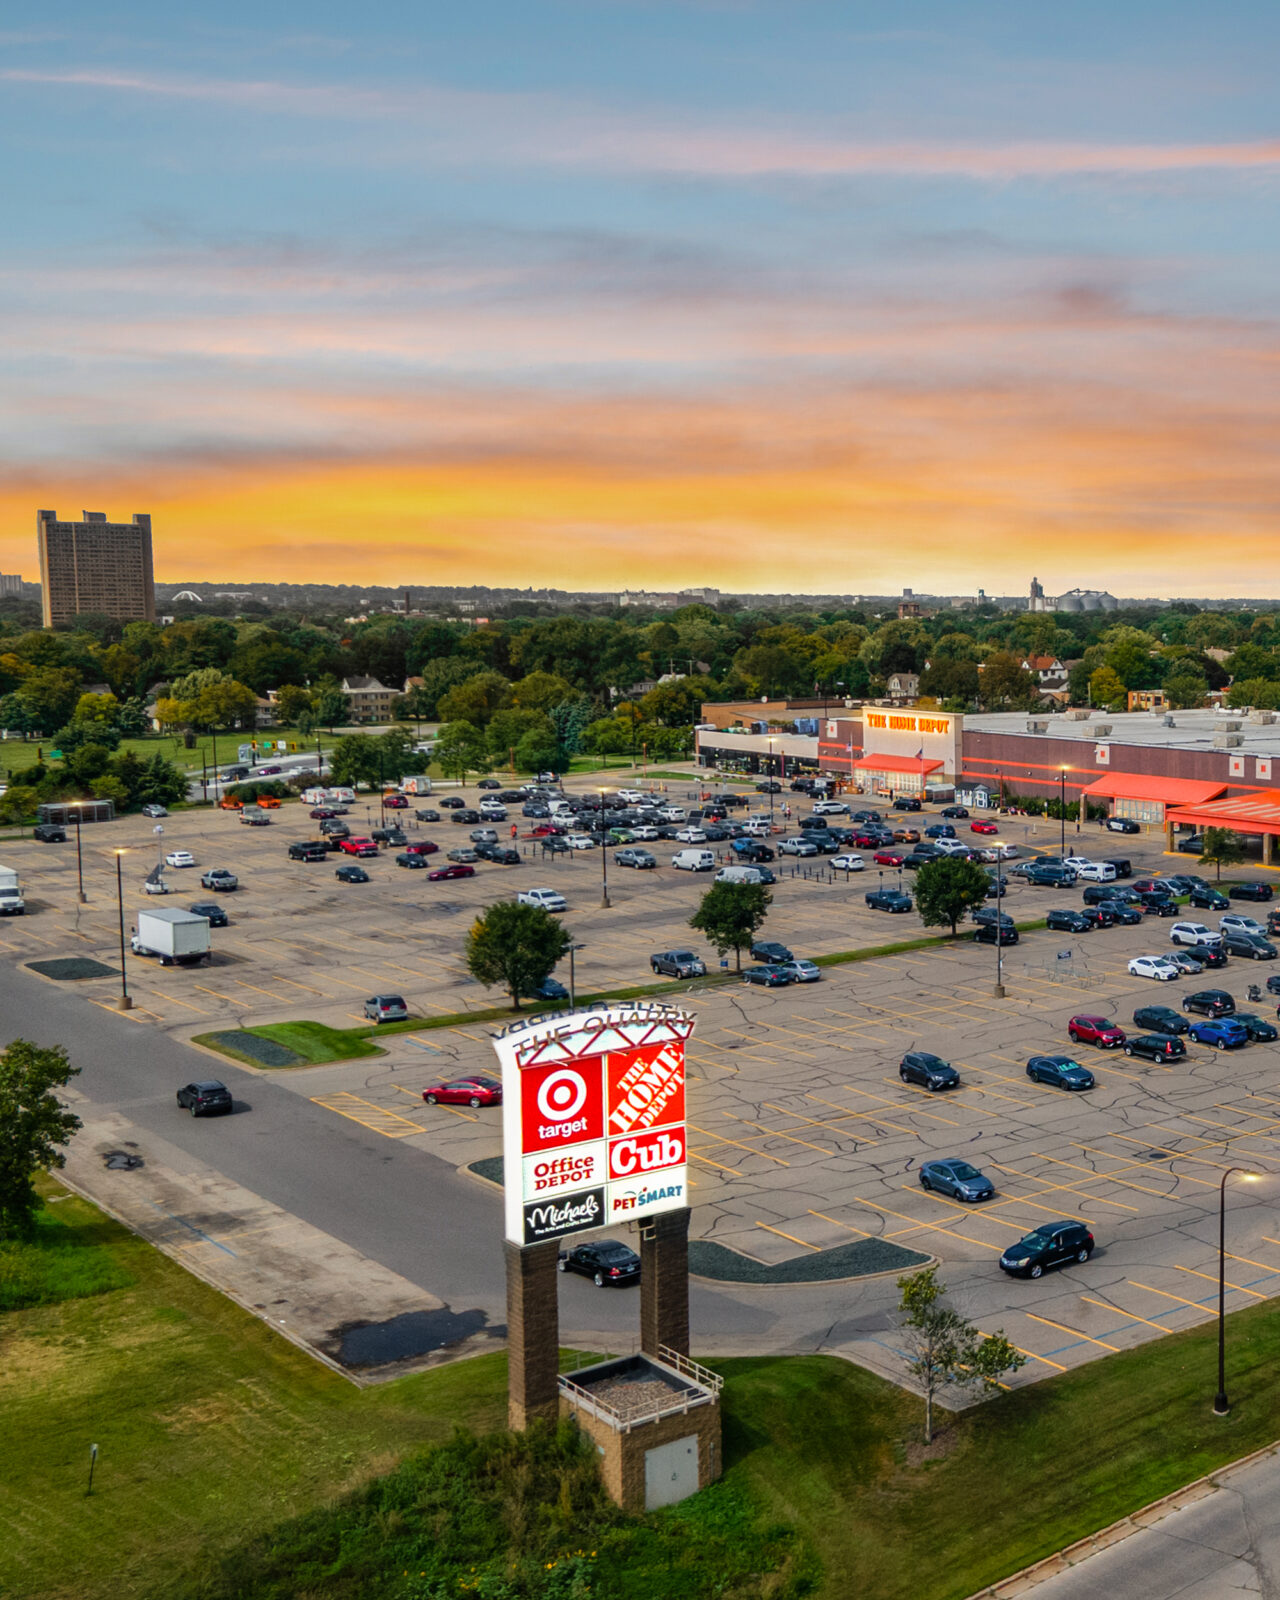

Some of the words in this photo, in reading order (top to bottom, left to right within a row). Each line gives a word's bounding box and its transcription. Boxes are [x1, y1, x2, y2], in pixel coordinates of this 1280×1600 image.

[867, 713, 886, 728] THE
[918, 718, 949, 734] DEPOT
[513, 1024, 571, 1057] THE
[583, 1006, 698, 1034] QUARRY
[609, 1043, 684, 1132] HOME
[616, 1057, 649, 1092] THE
[638, 1070, 685, 1128] DEPOT
[538, 1116, 588, 1139] target
[534, 1156, 594, 1178] Office
[611, 1134, 683, 1175] Cub
[534, 1168, 594, 1191] DEPOT
[526, 1194, 599, 1228] Michaels
